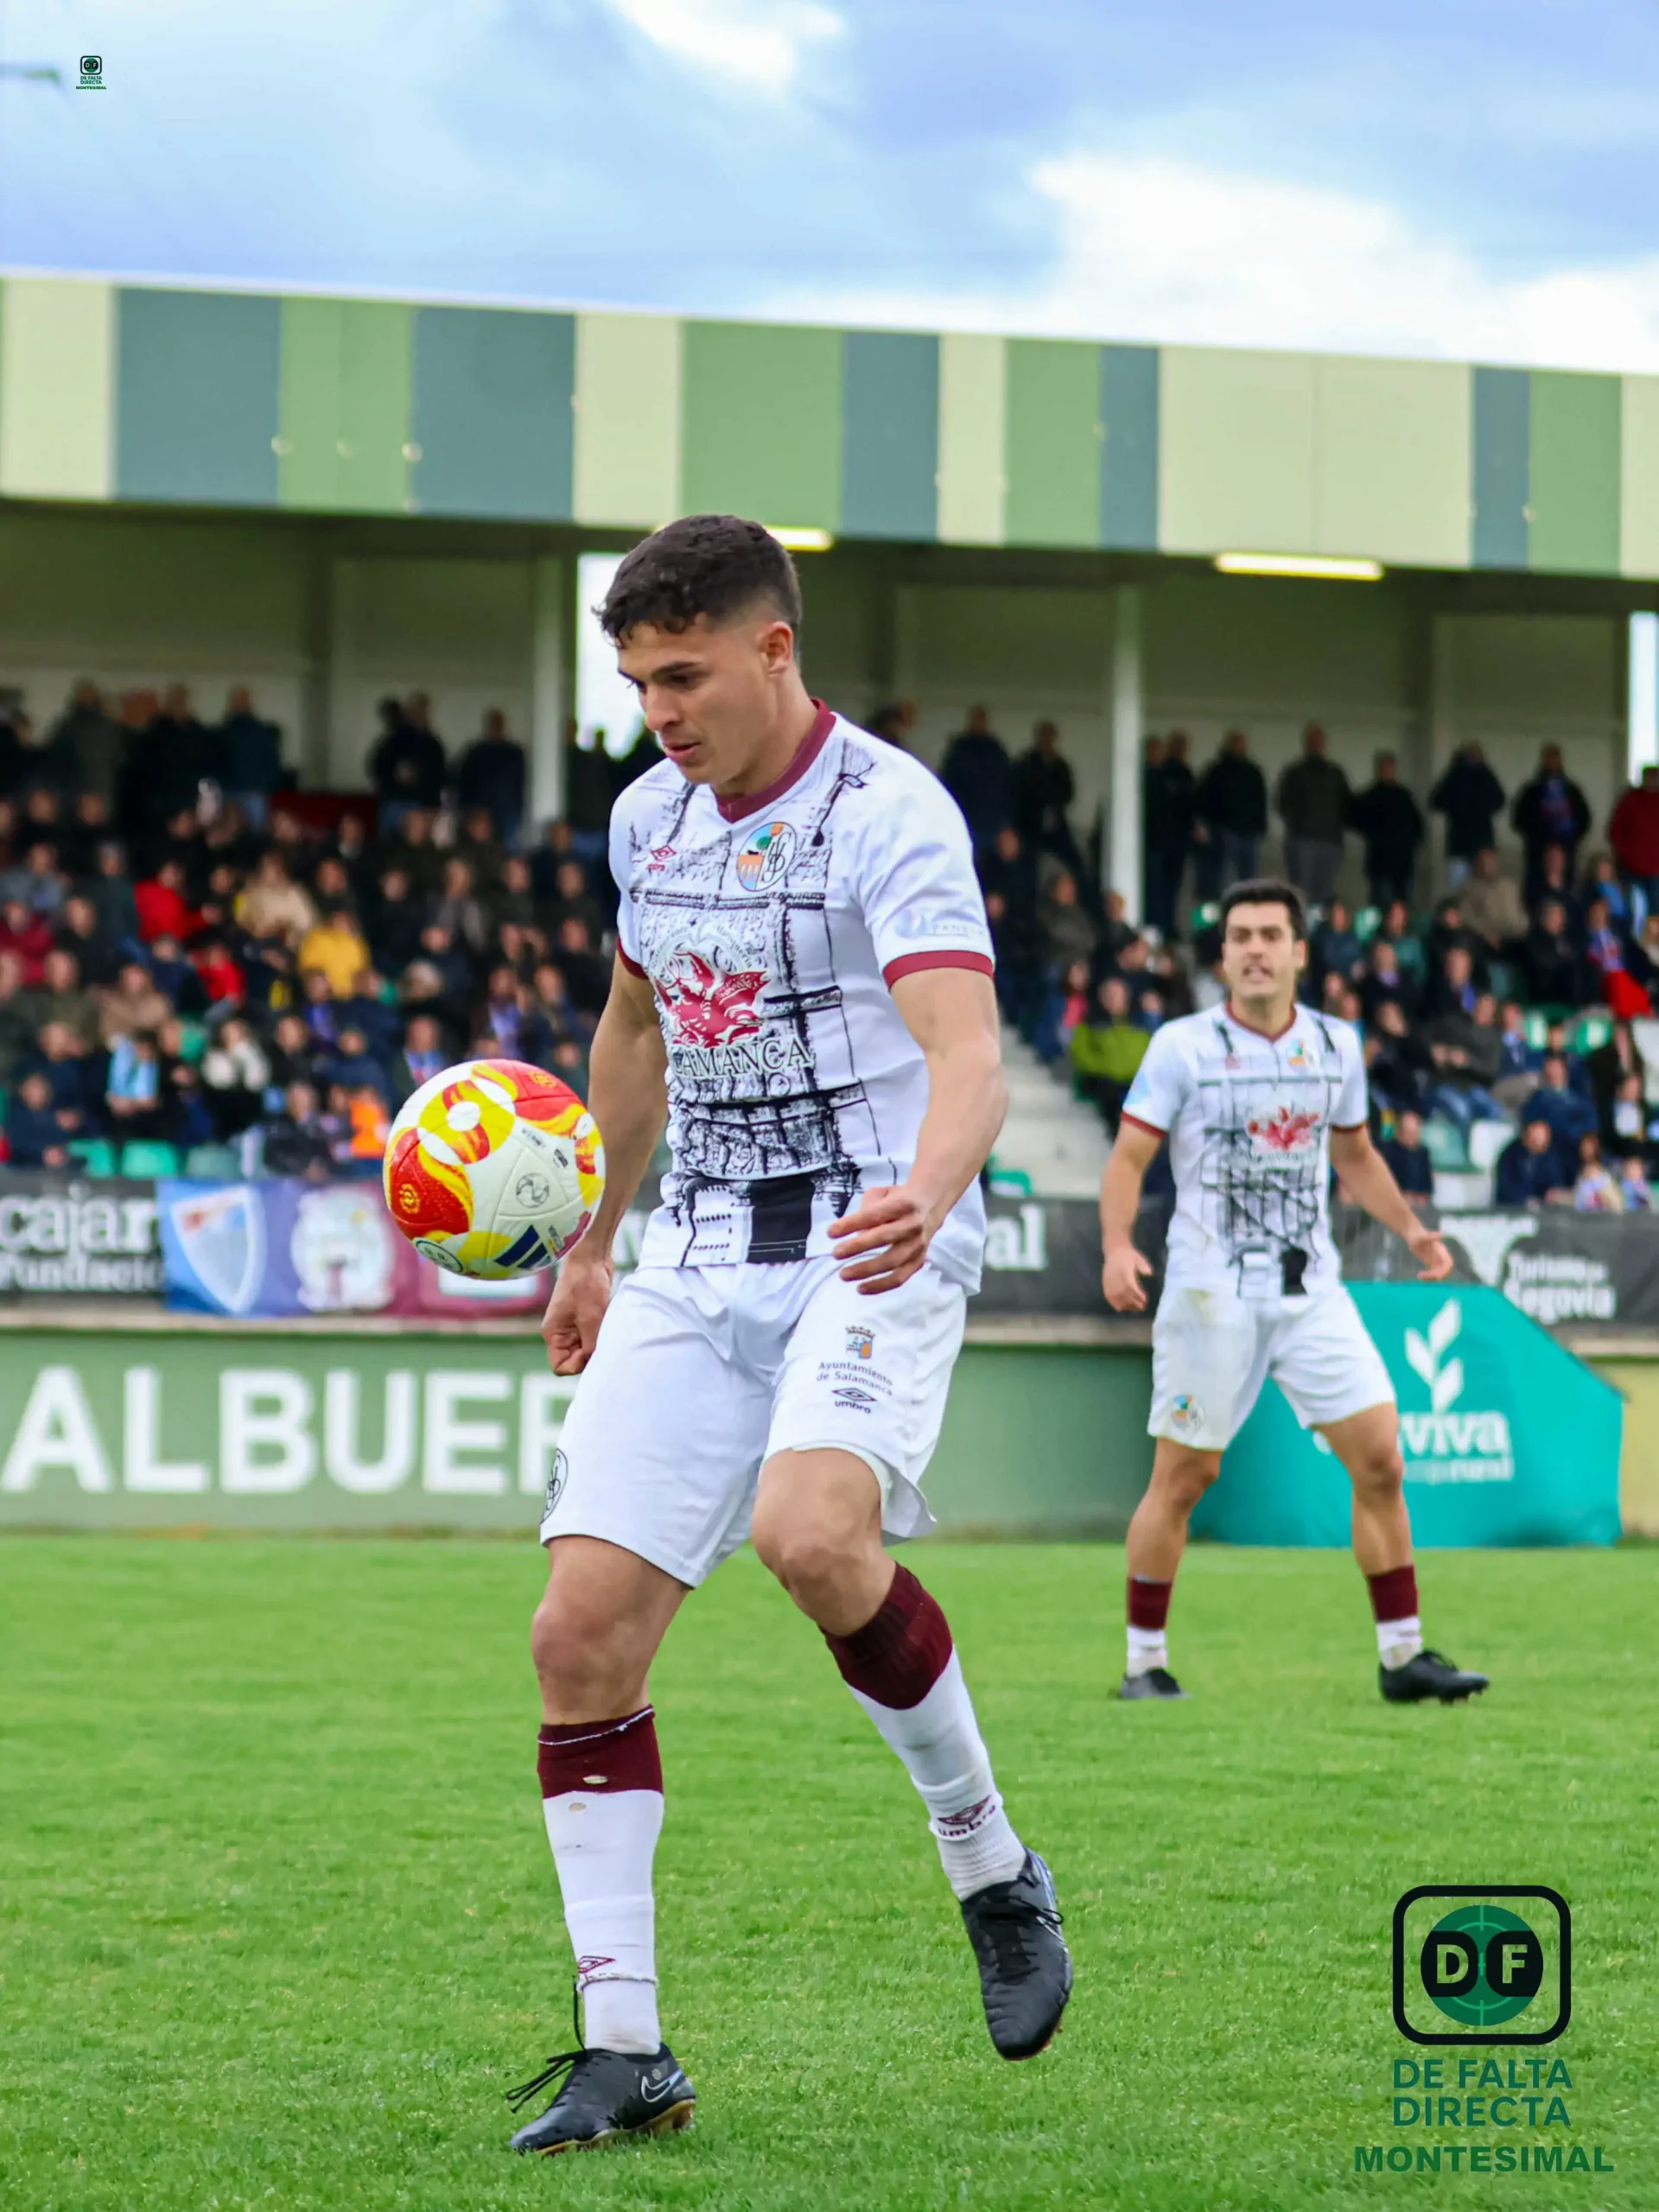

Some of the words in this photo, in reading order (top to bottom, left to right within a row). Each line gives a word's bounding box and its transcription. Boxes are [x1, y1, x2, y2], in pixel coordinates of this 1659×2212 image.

[816, 1371, 830, 1382] de
[834, 1370, 893, 1396] Salamanca
[818, 1362, 893, 1386] Ayuntamiento
[834, 1400, 872, 1414] umbro
